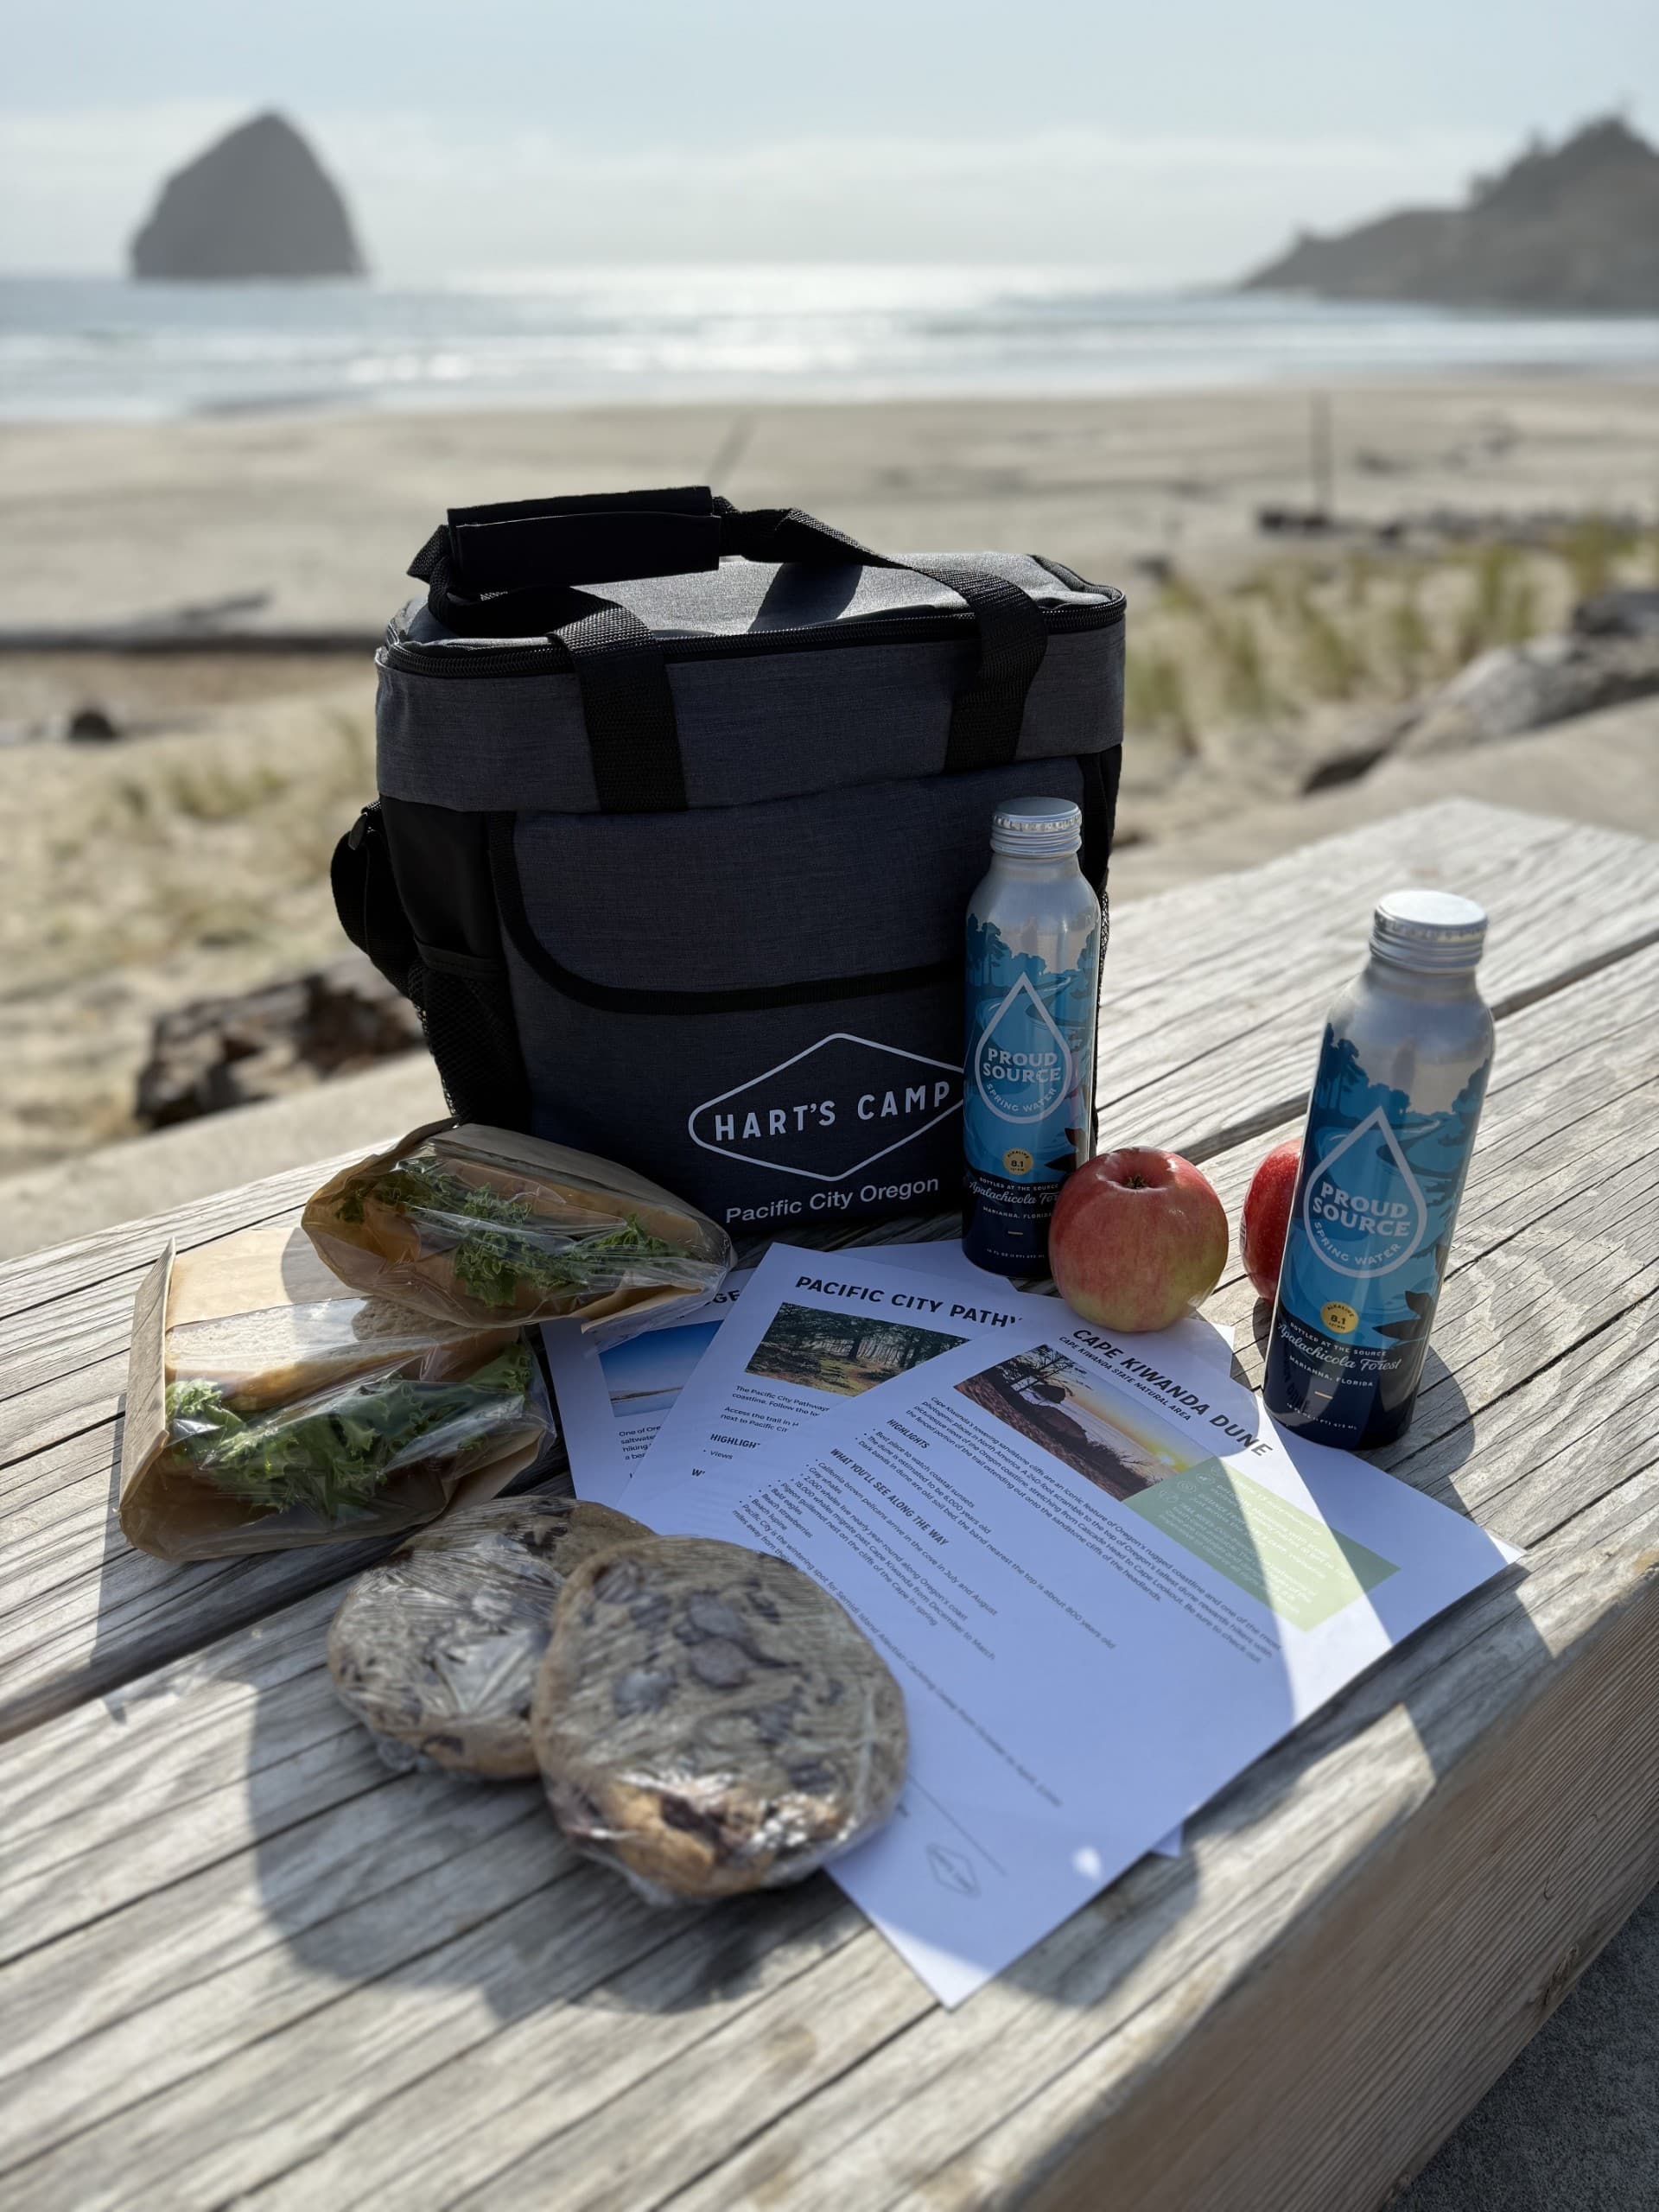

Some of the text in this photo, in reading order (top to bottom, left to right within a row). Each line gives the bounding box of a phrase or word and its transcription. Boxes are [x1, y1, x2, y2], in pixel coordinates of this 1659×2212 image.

[982, 1063, 1061, 1083] SOURCE
[988, 1048, 1058, 1066] PROUD
[715, 1081, 950, 1141] HART'S CAMP
[987, 1083, 1057, 1113] SPRING WATER
[969, 1181, 1037, 1205] Apalachicola
[979, 1177, 1004, 1188] BOTTLED
[725, 1179, 939, 1224] Pacific City Oregon
[1321, 1181, 1408, 1218] PROUD
[1313, 1197, 1411, 1237] SOURCE
[1314, 1222, 1402, 1266] SPRING WATER
[795, 1276, 885, 1302] PACIFIC
[891, 1294, 944, 1313] CITY
[1331, 1314, 1345, 1325] 8.1
[1277, 1323, 1403, 1372] Apalachicola Forest
[1290, 1321, 1319, 1343] BOTTLED
[1333, 1344, 1351, 1353] THE
[1058, 1336, 1192, 1421] CAPE KIWANDA STATE NATURAL AREA
[1289, 1355, 1373, 1387] MARIANNA, FLORIDA
[732, 1393, 767, 1404] coastline.
[769, 1401, 794, 1411] Follow
[751, 1389, 776, 1399] Pacific
[1072, 1329, 1124, 1359] CAPE
[1121, 1357, 1211, 1416] KIWANDA
[1210, 1414, 1274, 1457] DUNE
[721, 1414, 738, 1422] next
[749, 1420, 775, 1430] Pacific
[724, 1406, 750, 1416] Access
[710, 1433, 760, 1449] HIGHLIGH
[887, 1419, 931, 1449] HIGHLIGHTS
[710, 1451, 733, 1459] Views
[876, 1431, 892, 1441] Best
[887, 1440, 906, 1452] place
[911, 1457, 931, 1471] watch
[929, 1471, 953, 1489] coastal
[950, 1488, 976, 1508] sunsets
[916, 1416, 937, 1430] fenced
[933, 1430, 956, 1444] portion
[961, 1447, 972, 1456] the
[971, 1455, 986, 1465] trail
[983, 1465, 1014, 1489] extending
[1014, 1487, 1027, 1497] out
[809, 1466, 842, 1494] Gray whales
[868, 1435, 879, 1444] The
[878, 1443, 893, 1455] dune
[898, 1459, 930, 1482] estimated
[935, 1487, 944, 1496] be
[960, 1510, 980, 1524] years
[978, 1523, 993, 1534] old
[752, 1497, 788, 1530] Beach lupine
[772, 1487, 804, 1515] Bald eagles
[830, 1448, 949, 1546] WHAT YOU'LL SEE ALONG THE WAY
[858, 1440, 874, 1451] Dark
[872, 1450, 890, 1465] bands
[895, 1468, 912, 1482] dune
[912, 1481, 923, 1491] are
[921, 1490, 935, 1499] old
[932, 1499, 946, 1509] soil
[957, 1519, 970, 1530] the
[969, 1529, 989, 1544] band
[987, 1544, 1014, 1565] nearest
[1012, 1563, 1025, 1574] the
[1024, 1573, 1037, 1586] top
[762, 1492, 814, 1538] Beach strawberries
[818, 1461, 845, 1483] California
[843, 1482, 863, 1498] brown
[861, 1497, 887, 1520] pelicans
[886, 1519, 905, 1535] arrive
[911, 1540, 924, 1551] the
[922, 1551, 939, 1565] cove
[945, 1569, 960, 1584] July
[820, 1489, 842, 1506] whales
[840, 1504, 852, 1516] live
[850, 1515, 869, 1533] nearly
[901, 1561, 921, 1580] along
